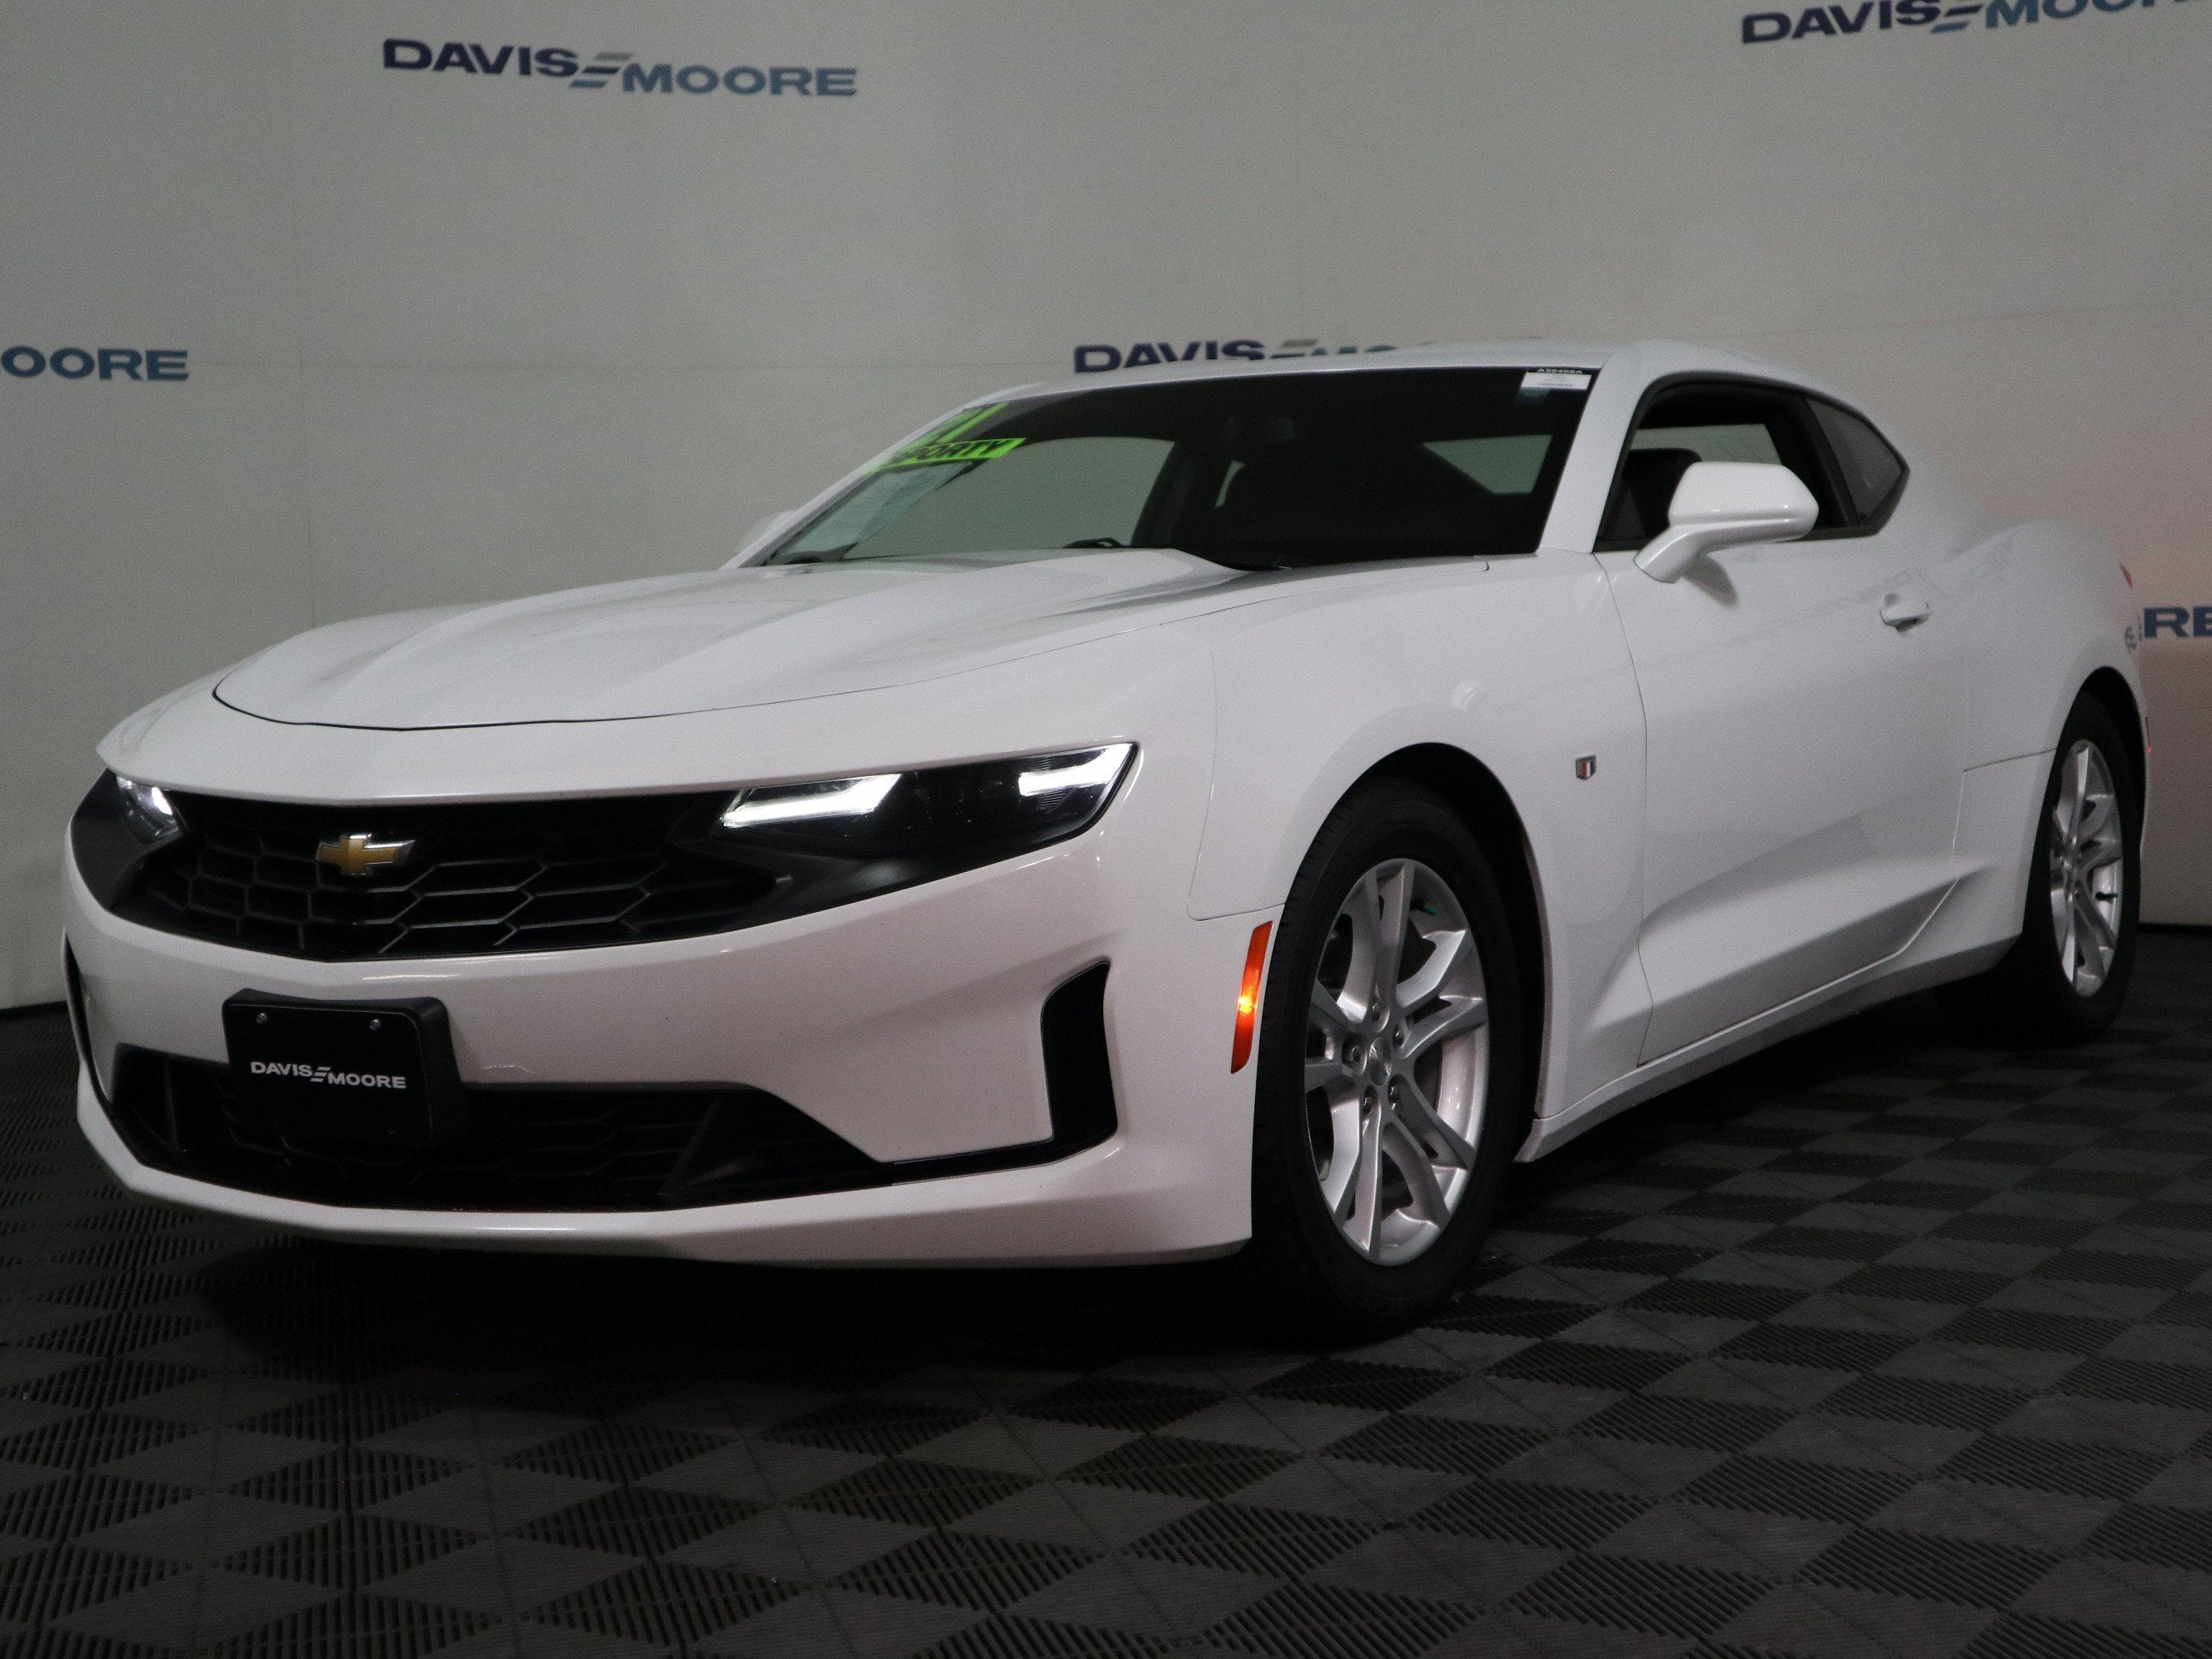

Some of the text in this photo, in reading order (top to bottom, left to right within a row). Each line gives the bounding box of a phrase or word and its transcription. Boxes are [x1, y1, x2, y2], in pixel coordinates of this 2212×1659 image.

[1741, 0, 1941, 44] DAVIS
[382, 38, 858, 97] DAVIS MOORE
[250, 1061, 407, 1089] DAVIS MOORE
